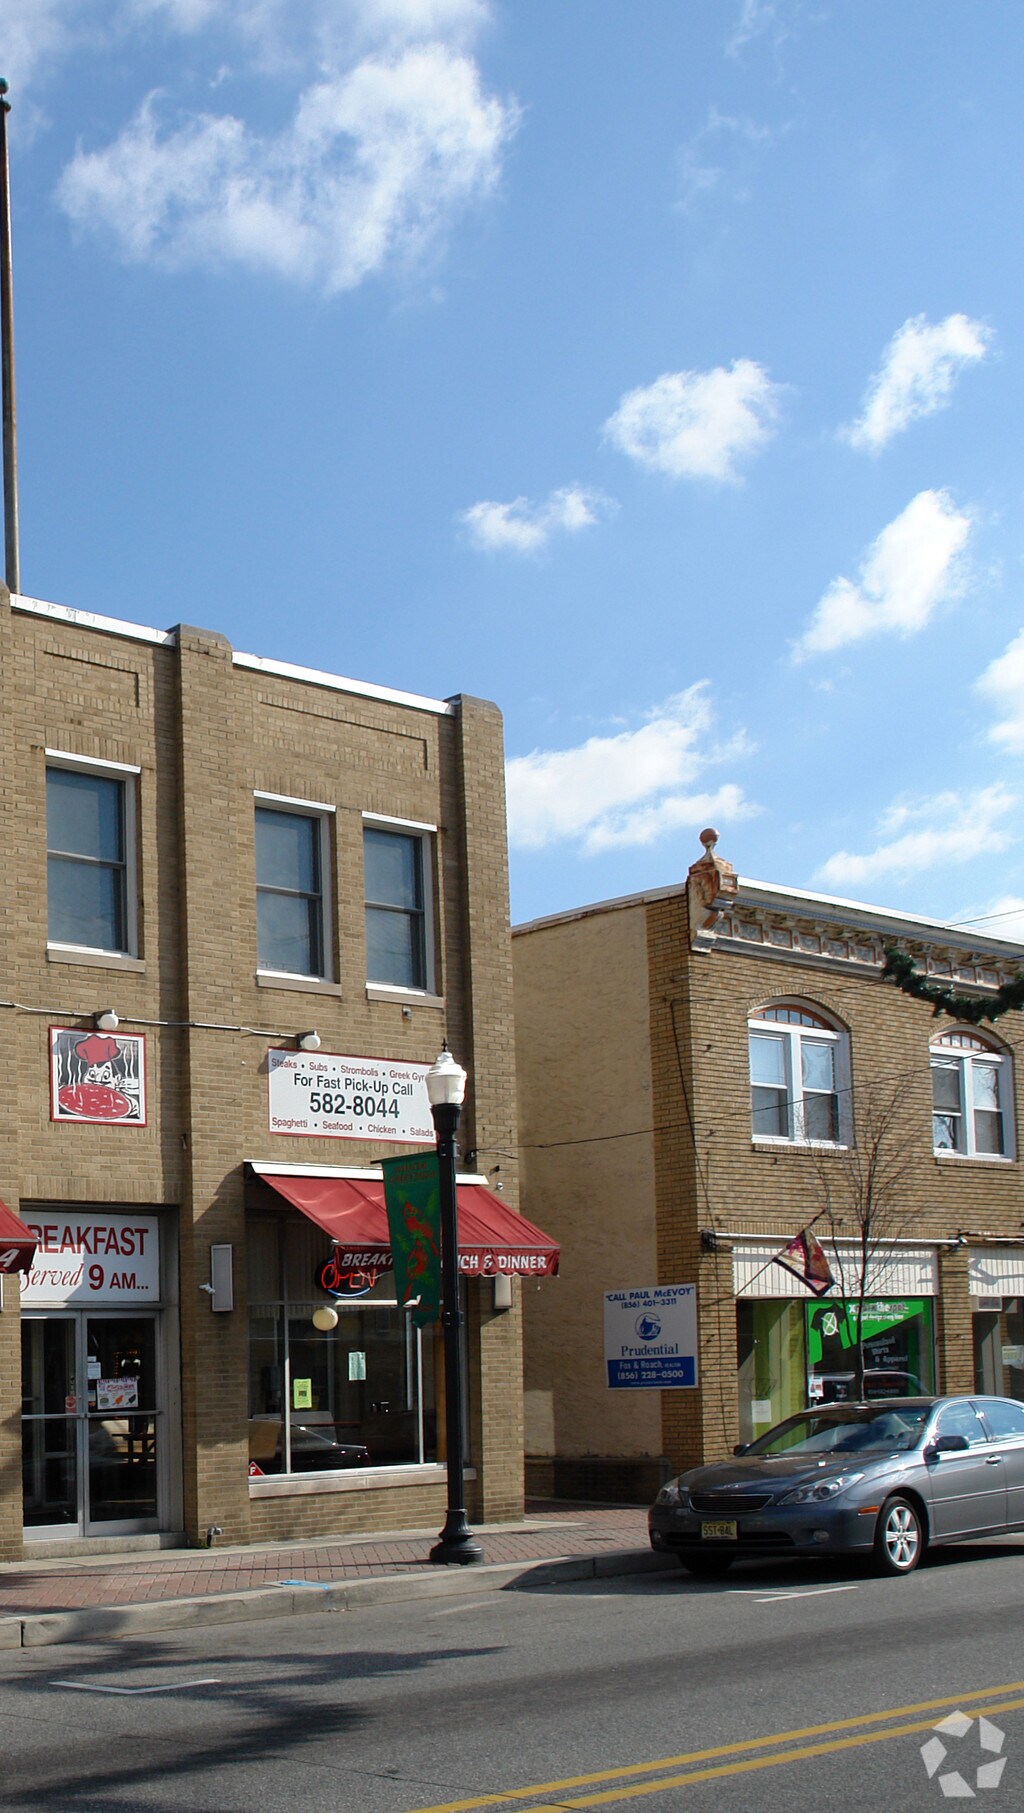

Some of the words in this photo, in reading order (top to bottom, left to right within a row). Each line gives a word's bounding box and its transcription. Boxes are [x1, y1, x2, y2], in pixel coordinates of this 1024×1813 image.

[271, 1058, 298, 1069] Steaks
[309, 1061, 328, 1072] Subs
[340, 1065, 379, 1077] Strombolis
[389, 1069, 410, 1080] Greek
[293, 1073, 313, 1087] For
[317, 1075, 341, 1089] Fast
[345, 1077, 389, 1097] Pick-Up
[392, 1082, 413, 1096] Call
[309, 1092, 400, 1119] 582-8044
[272, 1117, 308, 1129] Spaghetti
[322, 1120, 353, 1131] Seafood
[367, 1123, 396, 1135] Chicken
[409, 1127, 434, 1138] Salads
[483, 1254, 493, 1269] &
[497, 1254, 547, 1269] DINNER
[88, 1264, 105, 1290] 9
[629, 1291, 650, 1299] PAUL
[621, 1300, 640, 1309] (856)
[621, 1343, 679, 1357] Prudential
[619, 1361, 631, 1369] Fox
[617, 1372, 638, 1380] (856)
[641, 1370, 684, 1379] 228-0500
[249, 1466, 257, 1476] F
